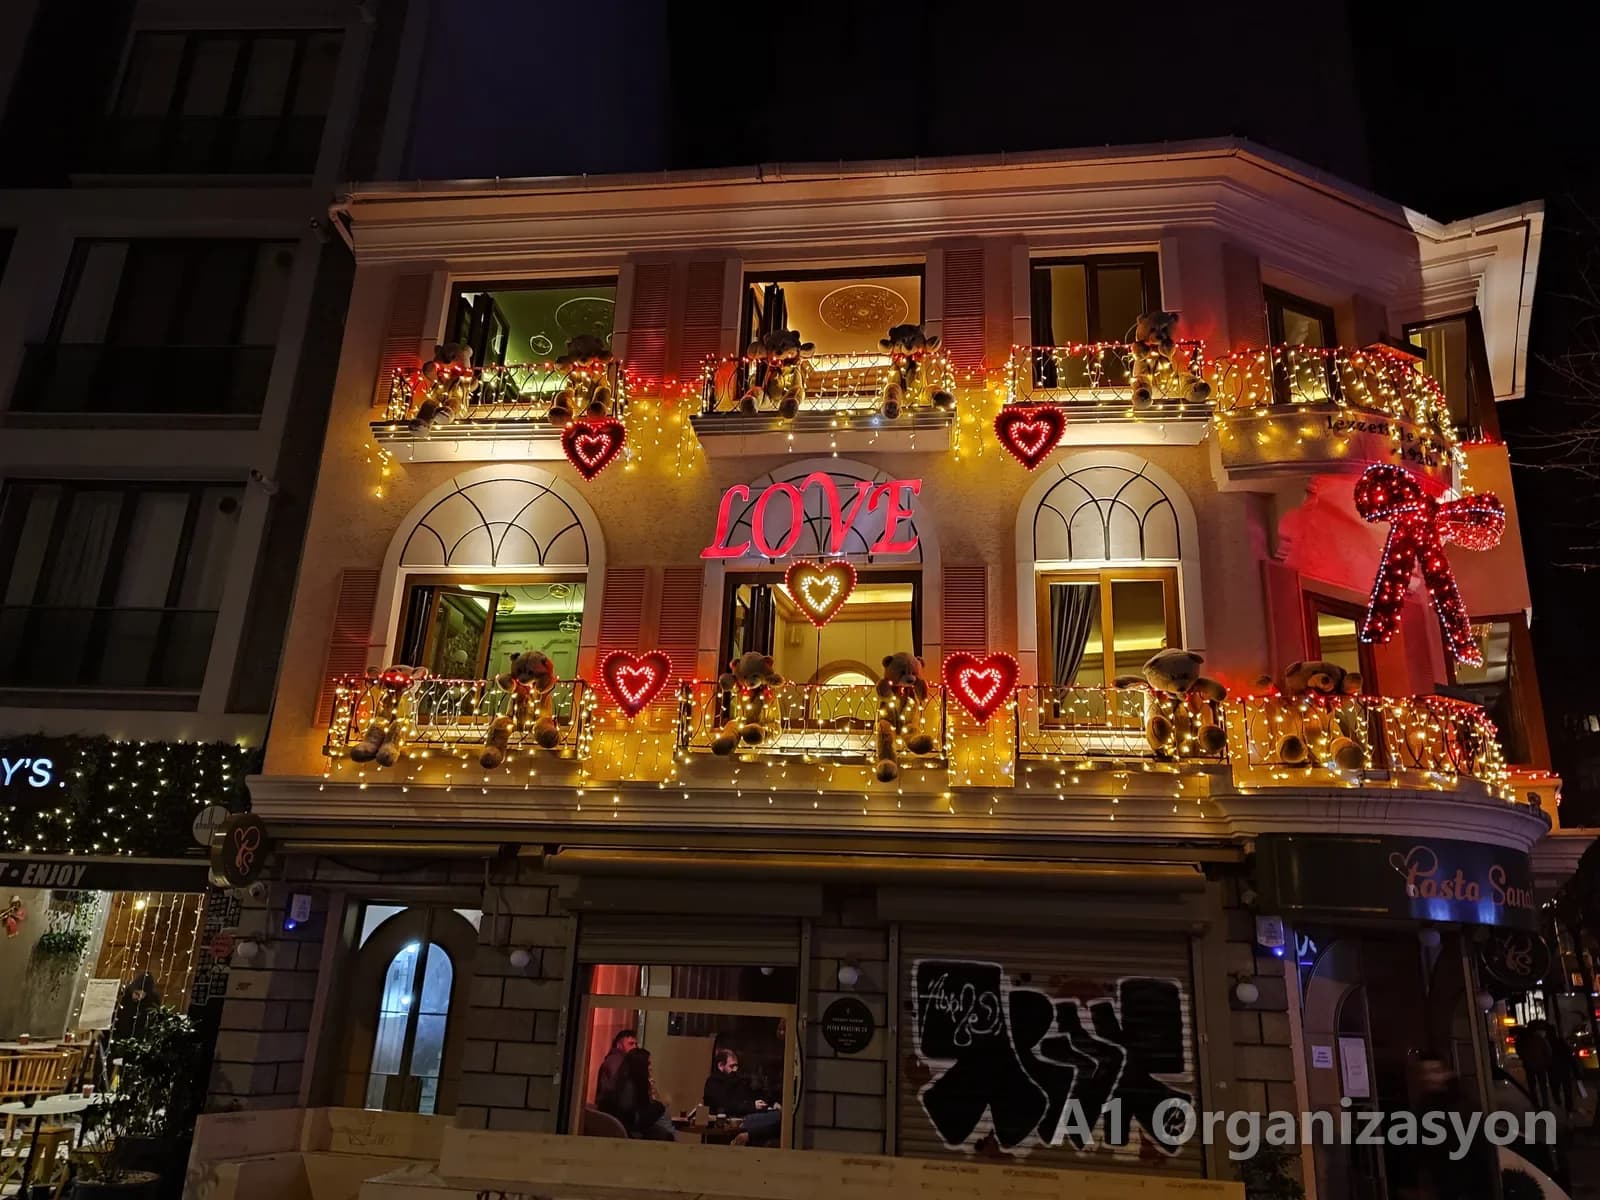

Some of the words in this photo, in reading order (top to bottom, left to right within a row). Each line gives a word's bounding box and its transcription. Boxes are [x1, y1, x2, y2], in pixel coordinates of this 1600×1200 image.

[700, 471, 922, 558] LOVE
[21, 863, 88, 887] ENJOY
[1388, 845, 1481, 901] Pasta
